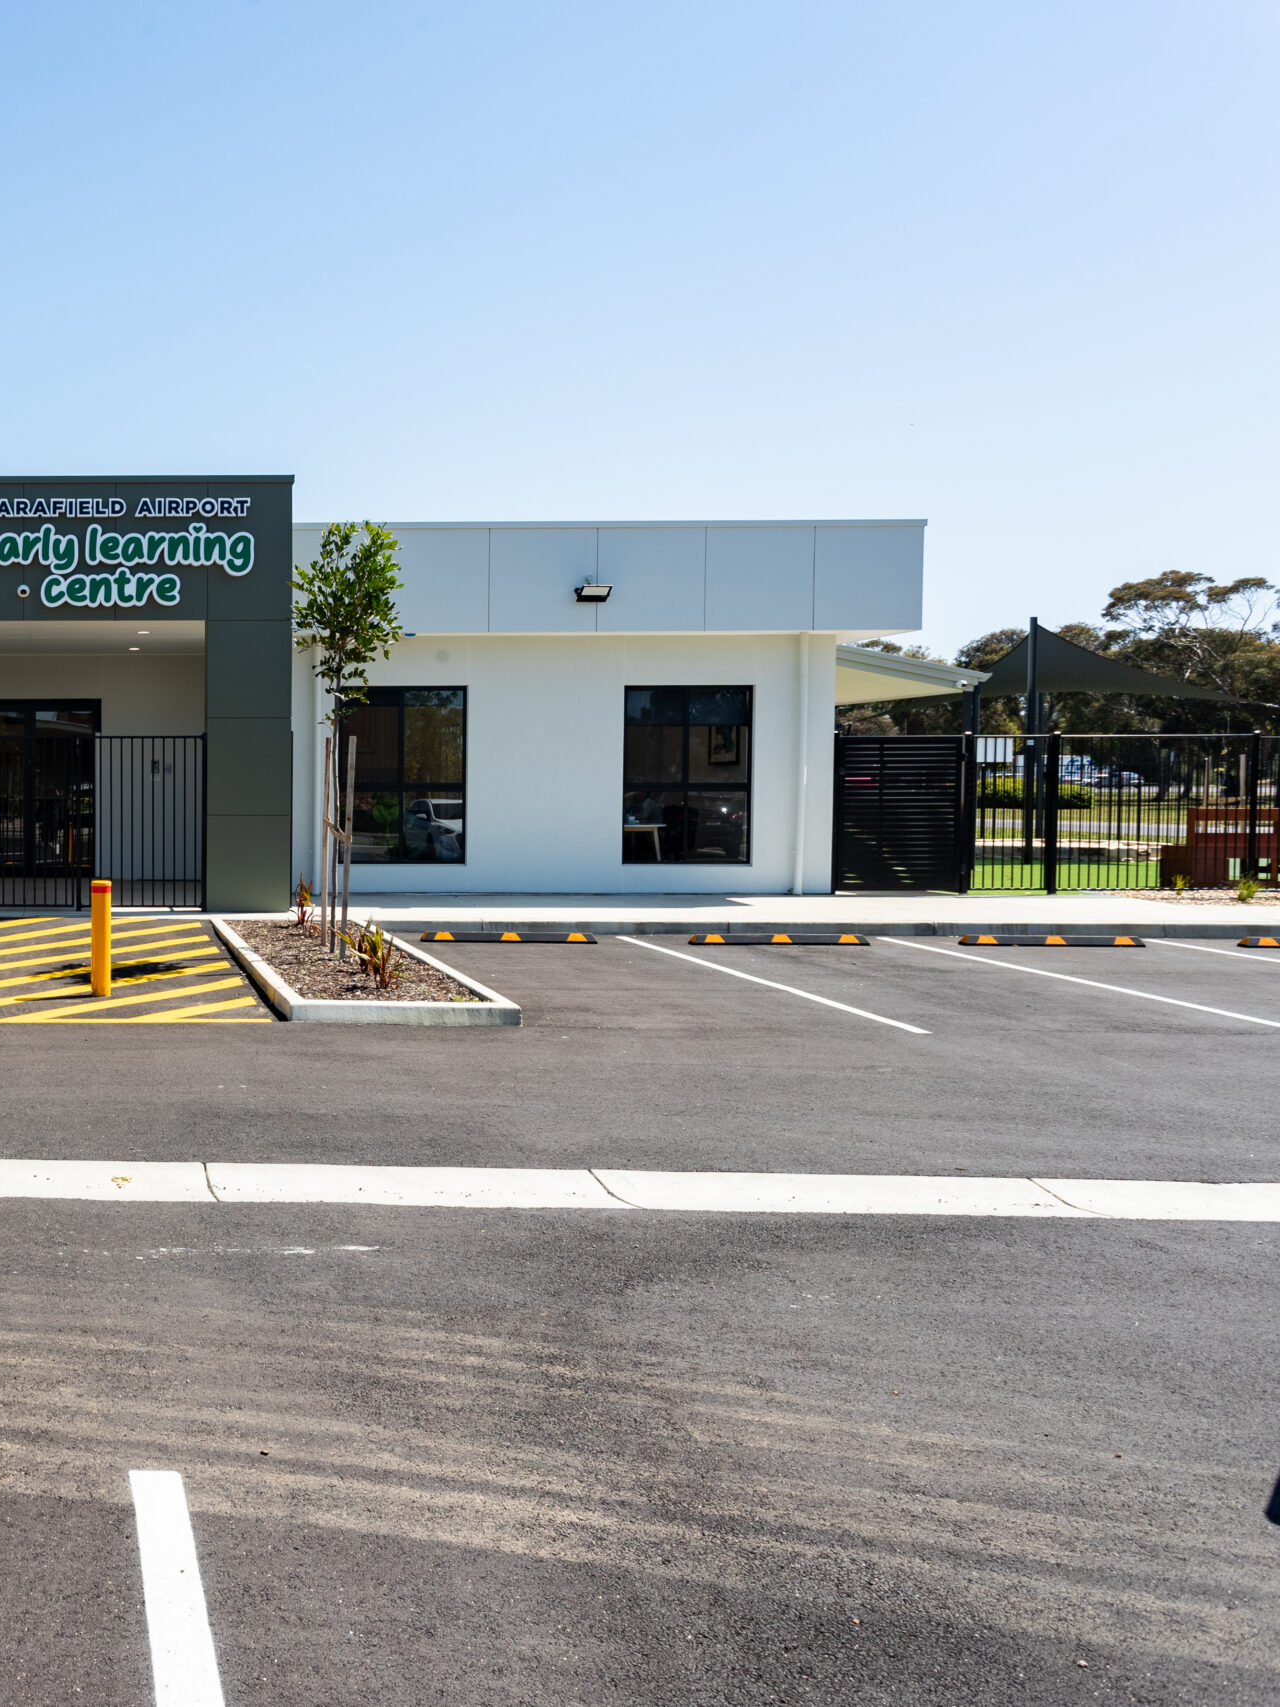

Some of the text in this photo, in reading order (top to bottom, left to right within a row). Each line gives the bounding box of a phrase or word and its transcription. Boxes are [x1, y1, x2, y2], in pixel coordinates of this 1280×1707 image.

[135, 498, 250, 517] AIRPORT
[86, 523, 254, 576] learning
[41, 567, 180, 607] centre
